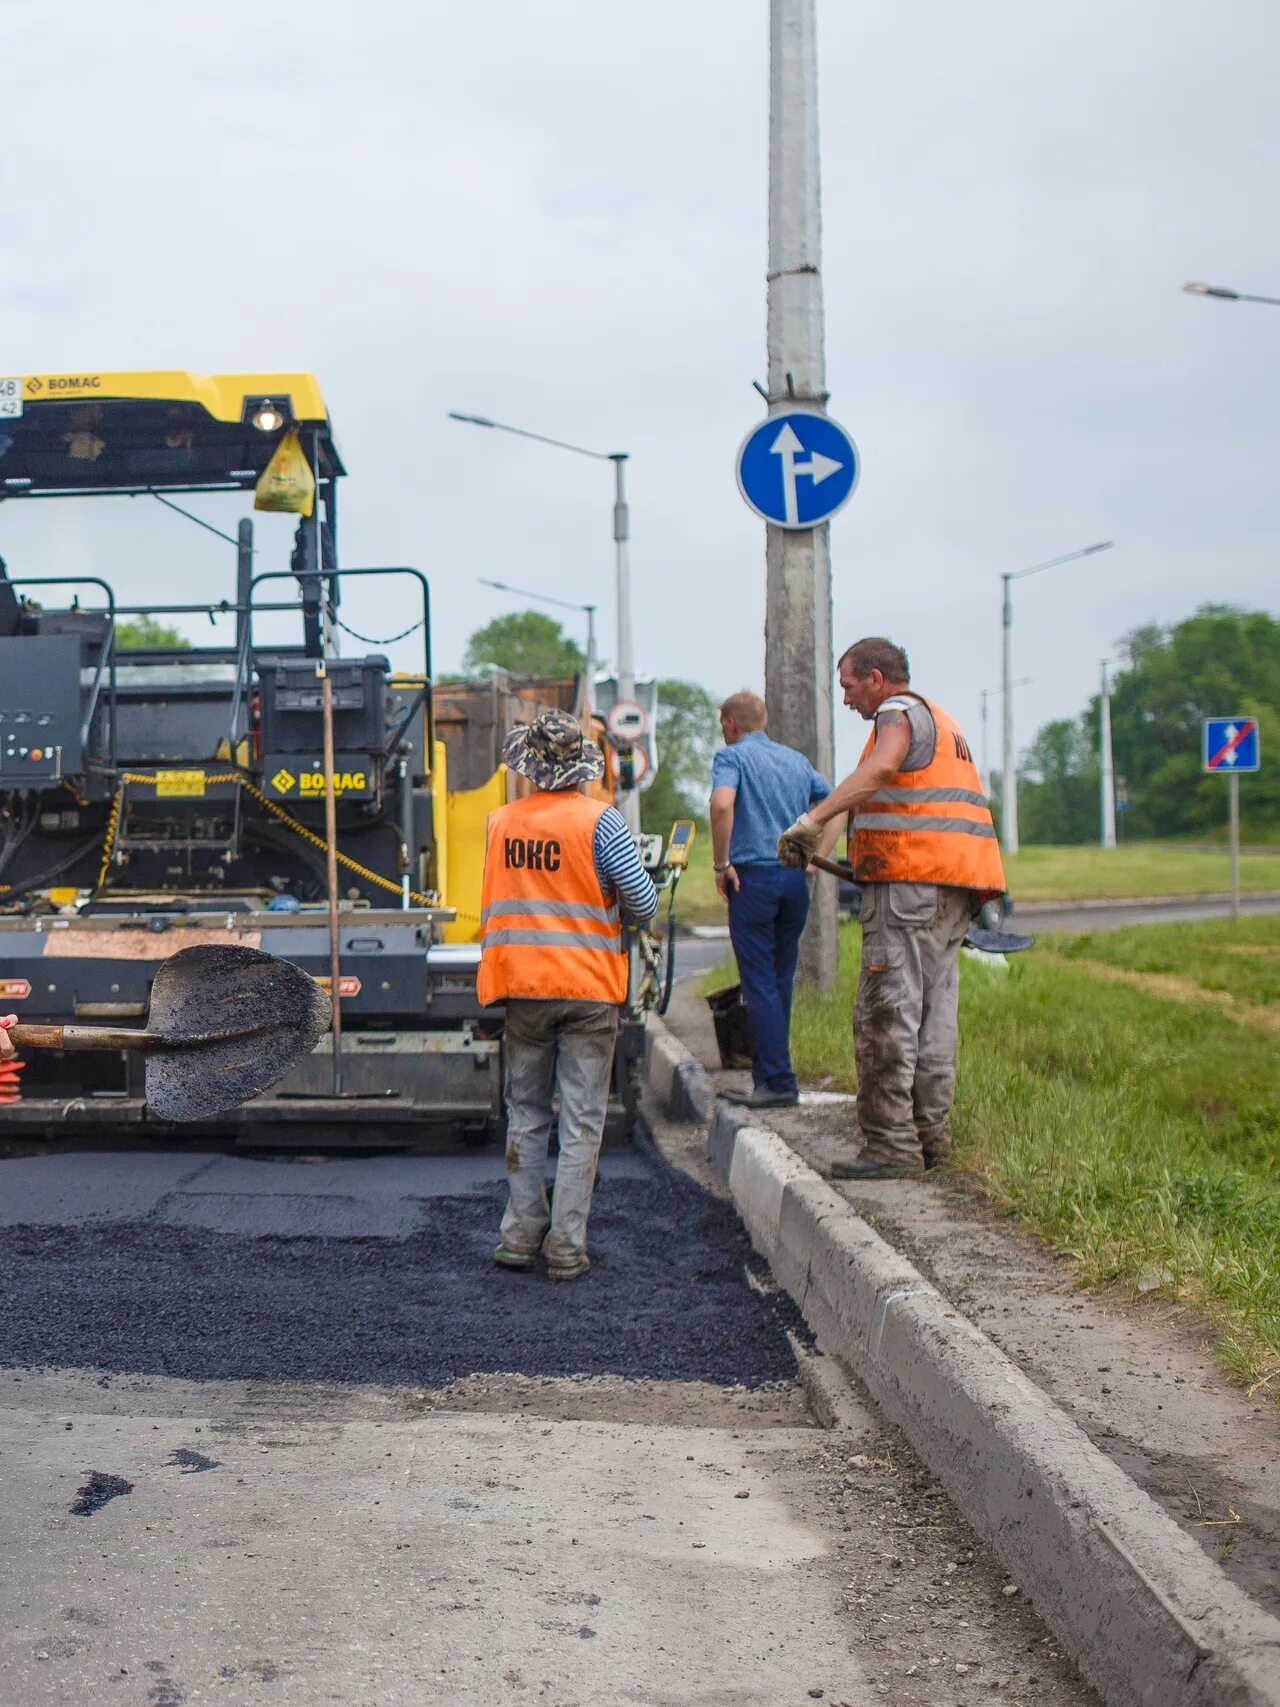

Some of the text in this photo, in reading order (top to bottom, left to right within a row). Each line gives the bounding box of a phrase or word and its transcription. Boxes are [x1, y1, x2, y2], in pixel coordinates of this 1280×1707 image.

[48, 376, 101, 390] BOMAG
[1, 402, 18, 414] 42
[504, 837, 561, 872] ЮКС
